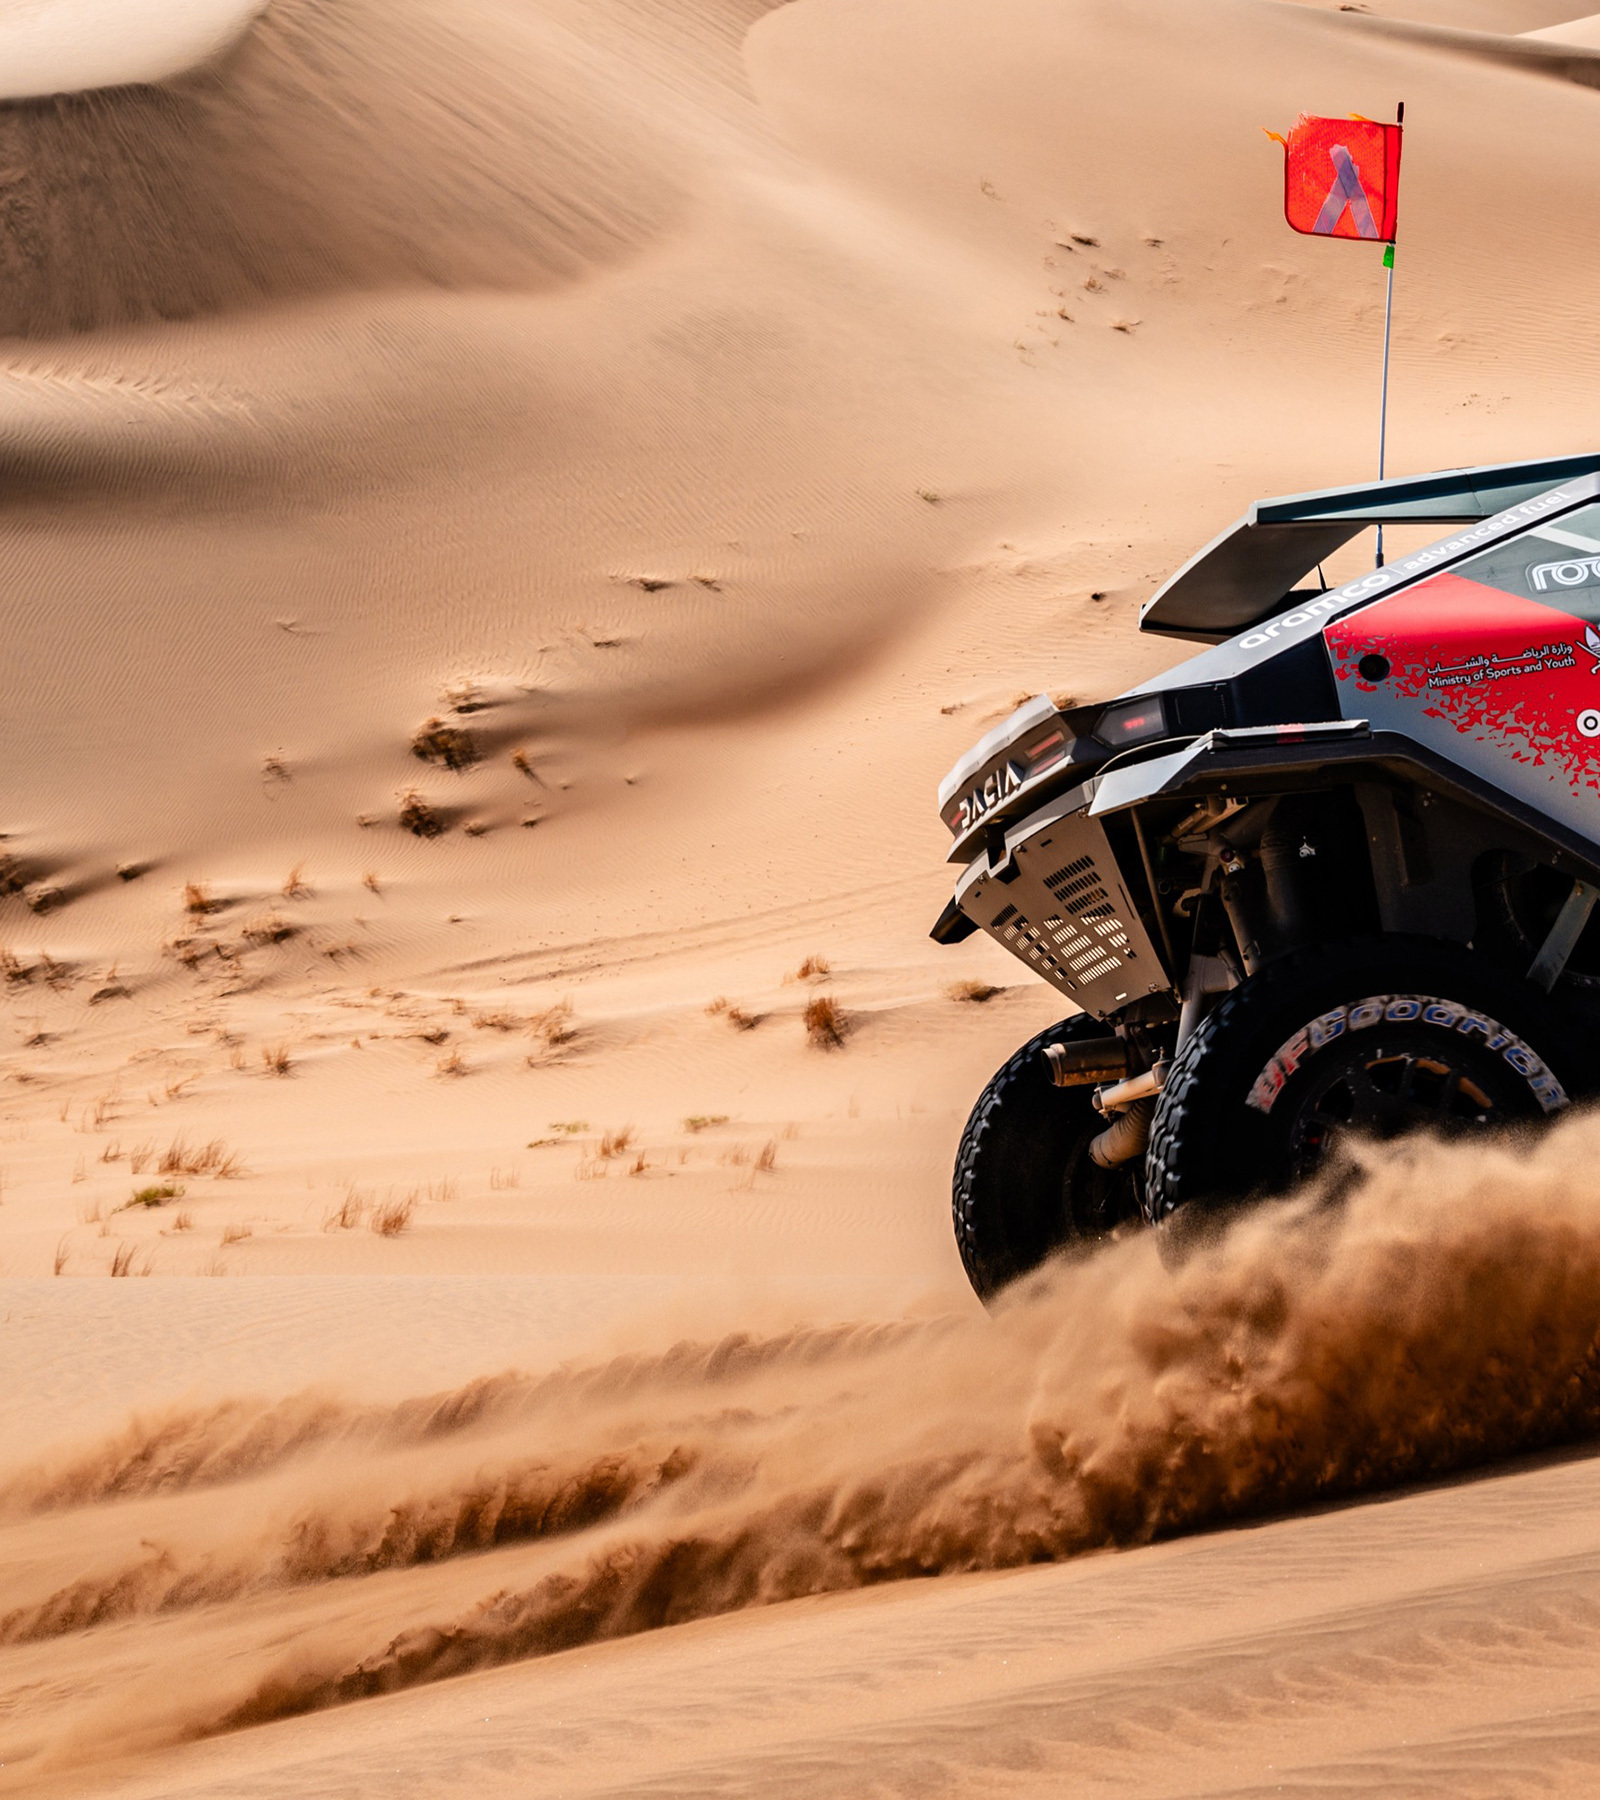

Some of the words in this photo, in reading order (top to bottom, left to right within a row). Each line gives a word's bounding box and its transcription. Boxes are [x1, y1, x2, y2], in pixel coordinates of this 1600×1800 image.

[1238, 573, 1391, 650] aramco
[1403, 513, 1521, 571] advanced
[1519, 491, 1572, 517] fuel
[1428, 674, 1472, 688] Ministry
[1473, 671, 1485, 681] of
[1486, 665, 1522, 680] Sports
[1524, 661, 1542, 673] and
[1544, 656, 1576, 669] Youth
